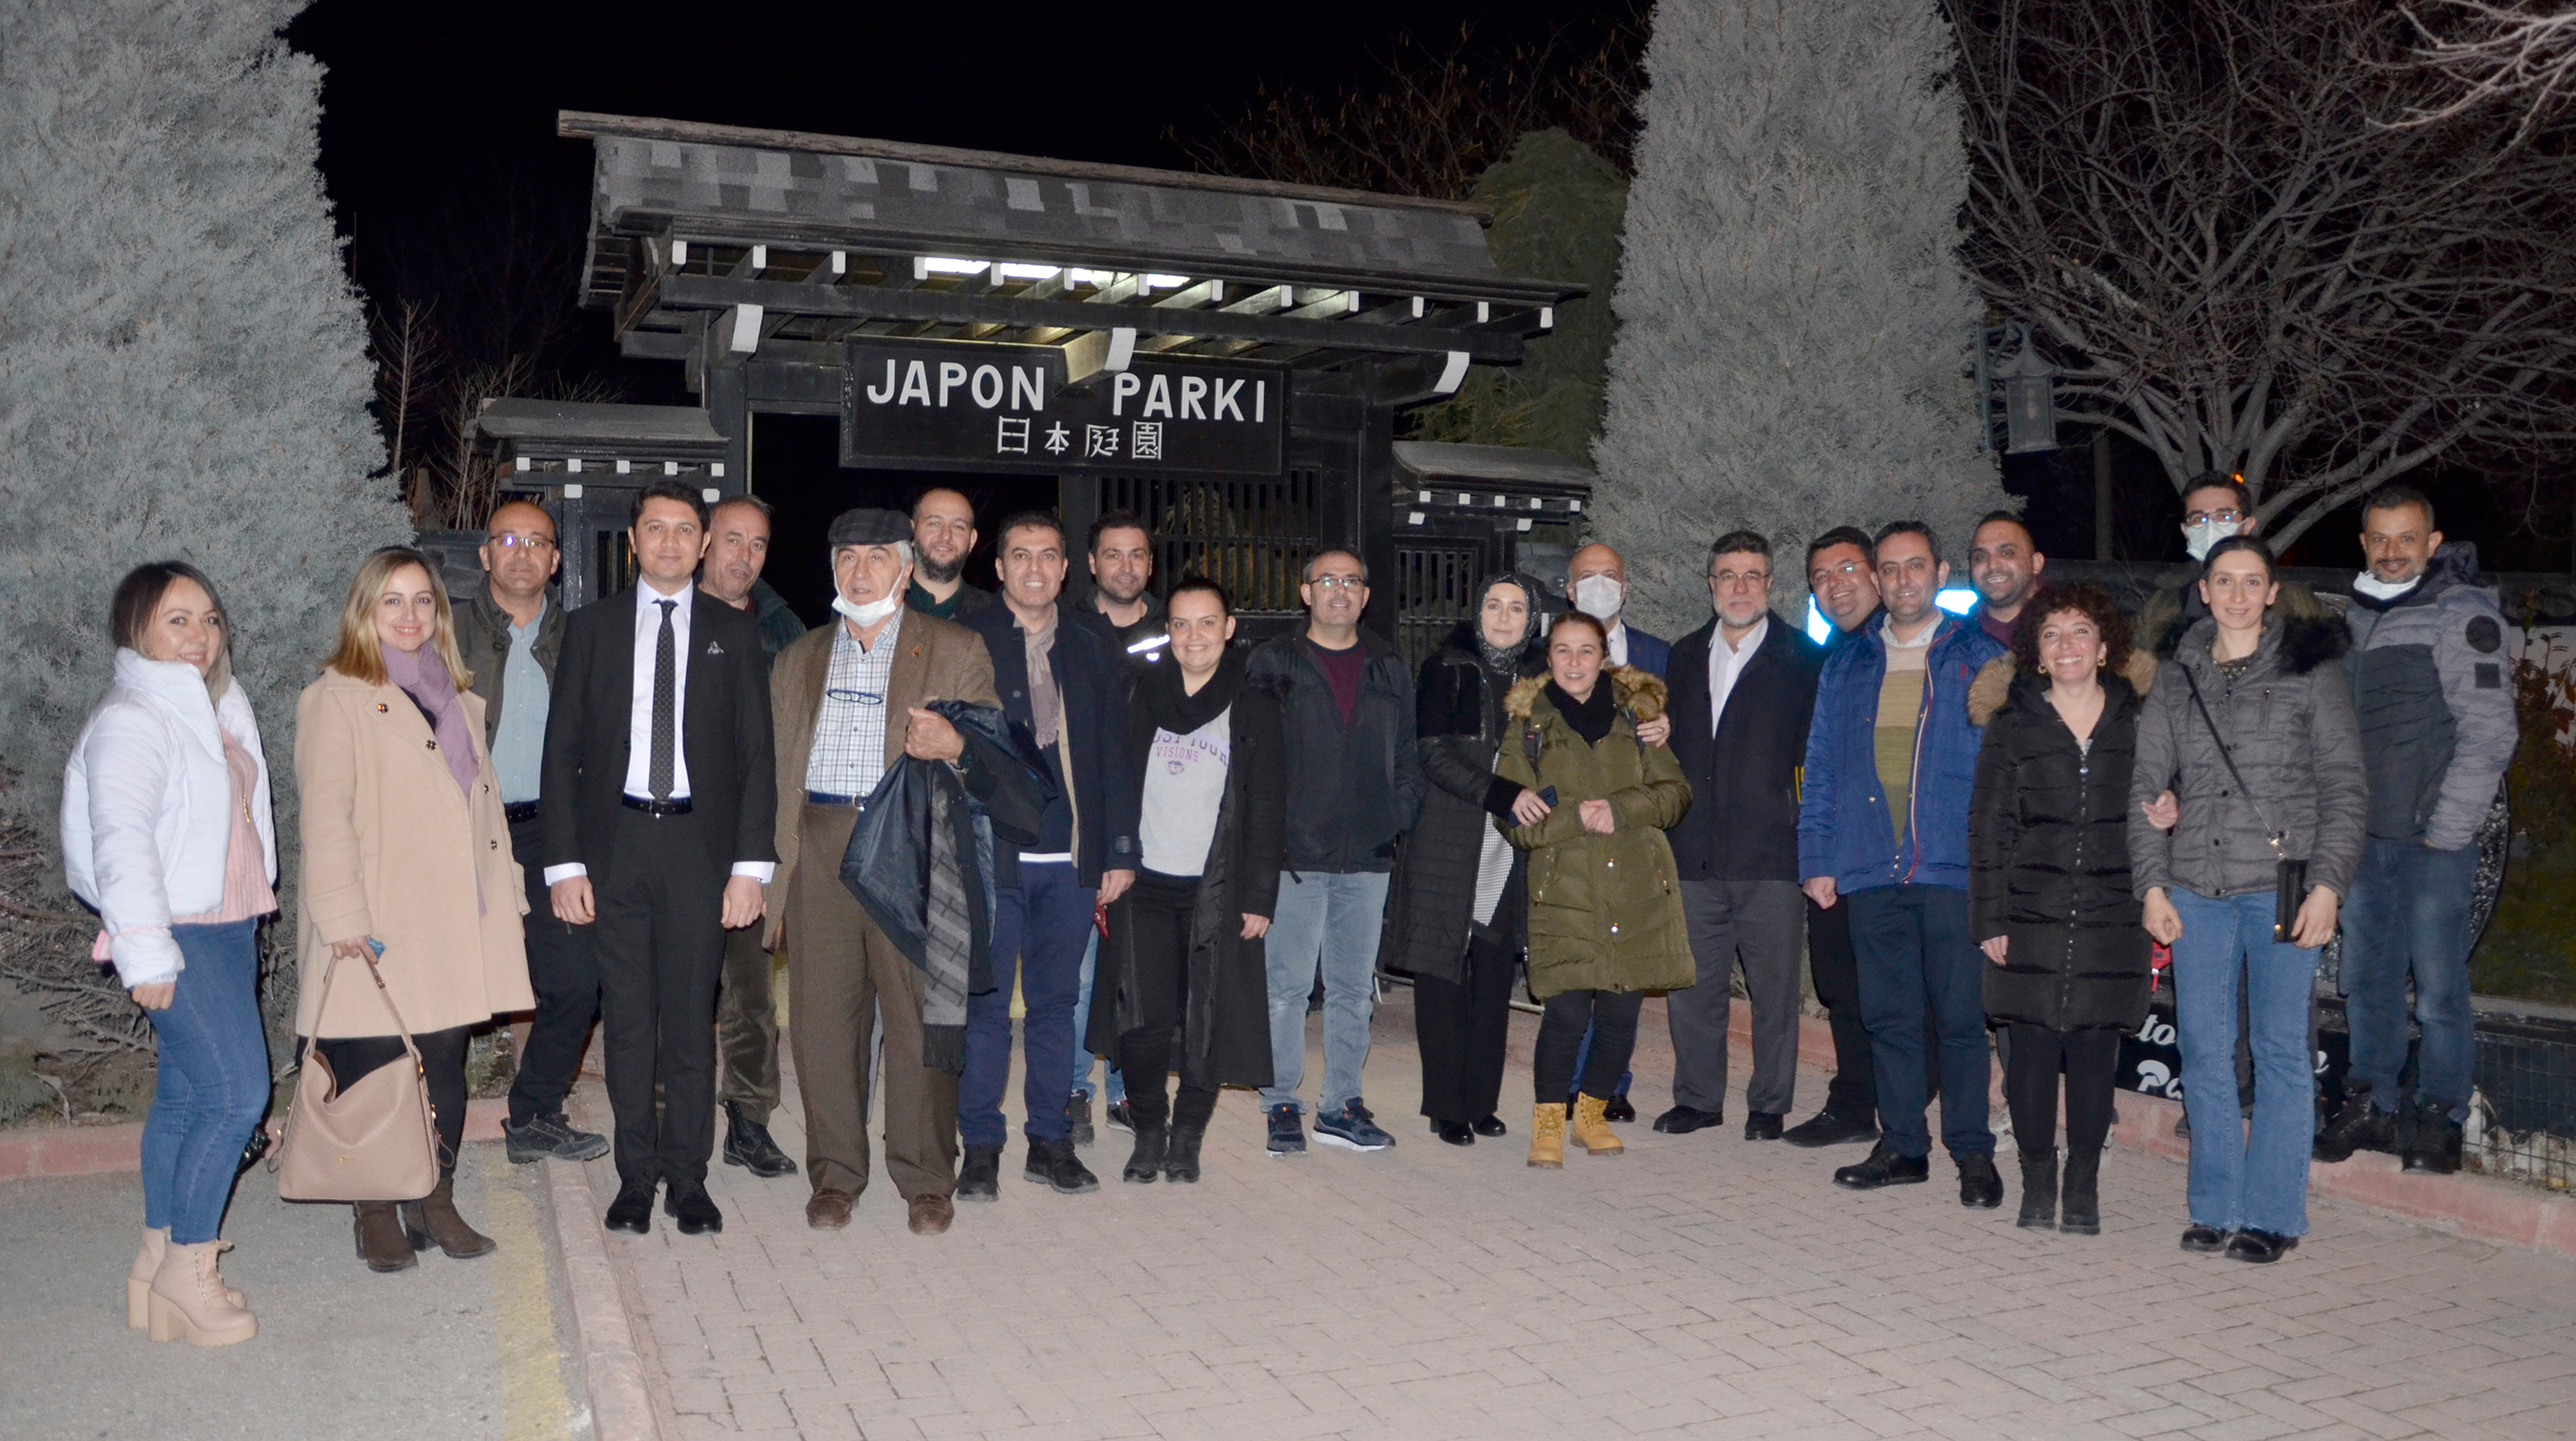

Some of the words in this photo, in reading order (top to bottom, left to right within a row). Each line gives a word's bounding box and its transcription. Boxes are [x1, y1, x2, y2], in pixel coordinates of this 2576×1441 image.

[866, 359, 1045, 411] JAPON
[1112, 372, 1265, 423] PARKI
[997, 415, 1163, 460] 日本庭園
[1156, 745, 1199, 762] VISIONS
